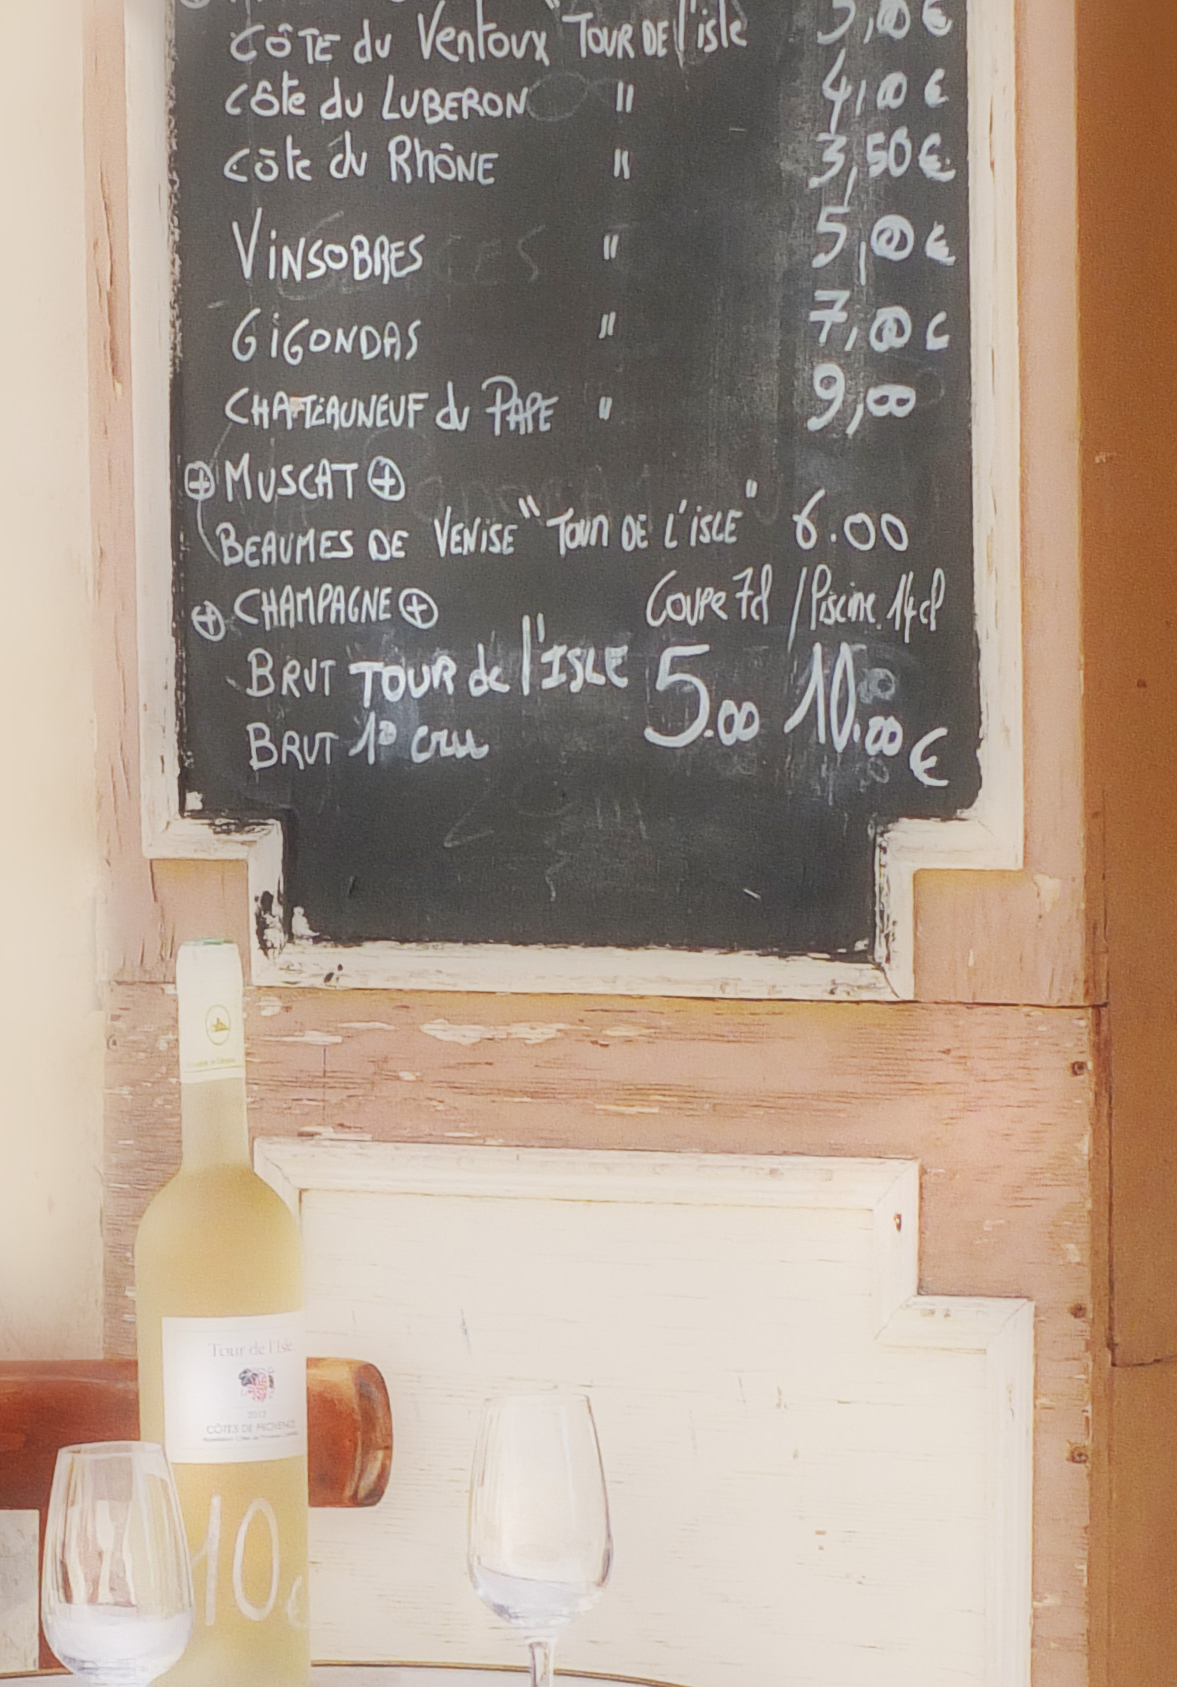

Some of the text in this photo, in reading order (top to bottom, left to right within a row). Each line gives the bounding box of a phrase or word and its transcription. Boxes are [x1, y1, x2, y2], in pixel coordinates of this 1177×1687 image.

[353, 19, 392, 64] du
[417, 0, 550, 66] Ventoux
[225, 70, 306, 116] Côte
[321, 77, 363, 120] du
[382, 74, 529, 124] LUBERON
[223, 135, 313, 181] Côte
[330, 130, 368, 178] du
[808, 126, 912, 206] 3,50
[435, 381, 470, 431] du
[481, 375, 559, 436] PAPE
[224, 453, 359, 502] MUSCAT
[216, 522, 354, 567] BEAUMES
[368, 529, 409, 562] DE
[792, 489, 909, 552] 6.00
[233, 583, 393, 631] CHAMPAGNE
[246, 648, 336, 698] BRUT
[348, 655, 458, 708] TOUR
[468, 643, 512, 698] de
[643, 644, 761, 749] 5.00
[783, 641, 905, 756] 10.00
[909, 727, 950, 788] €
[246, 722, 340, 771] BRUT
